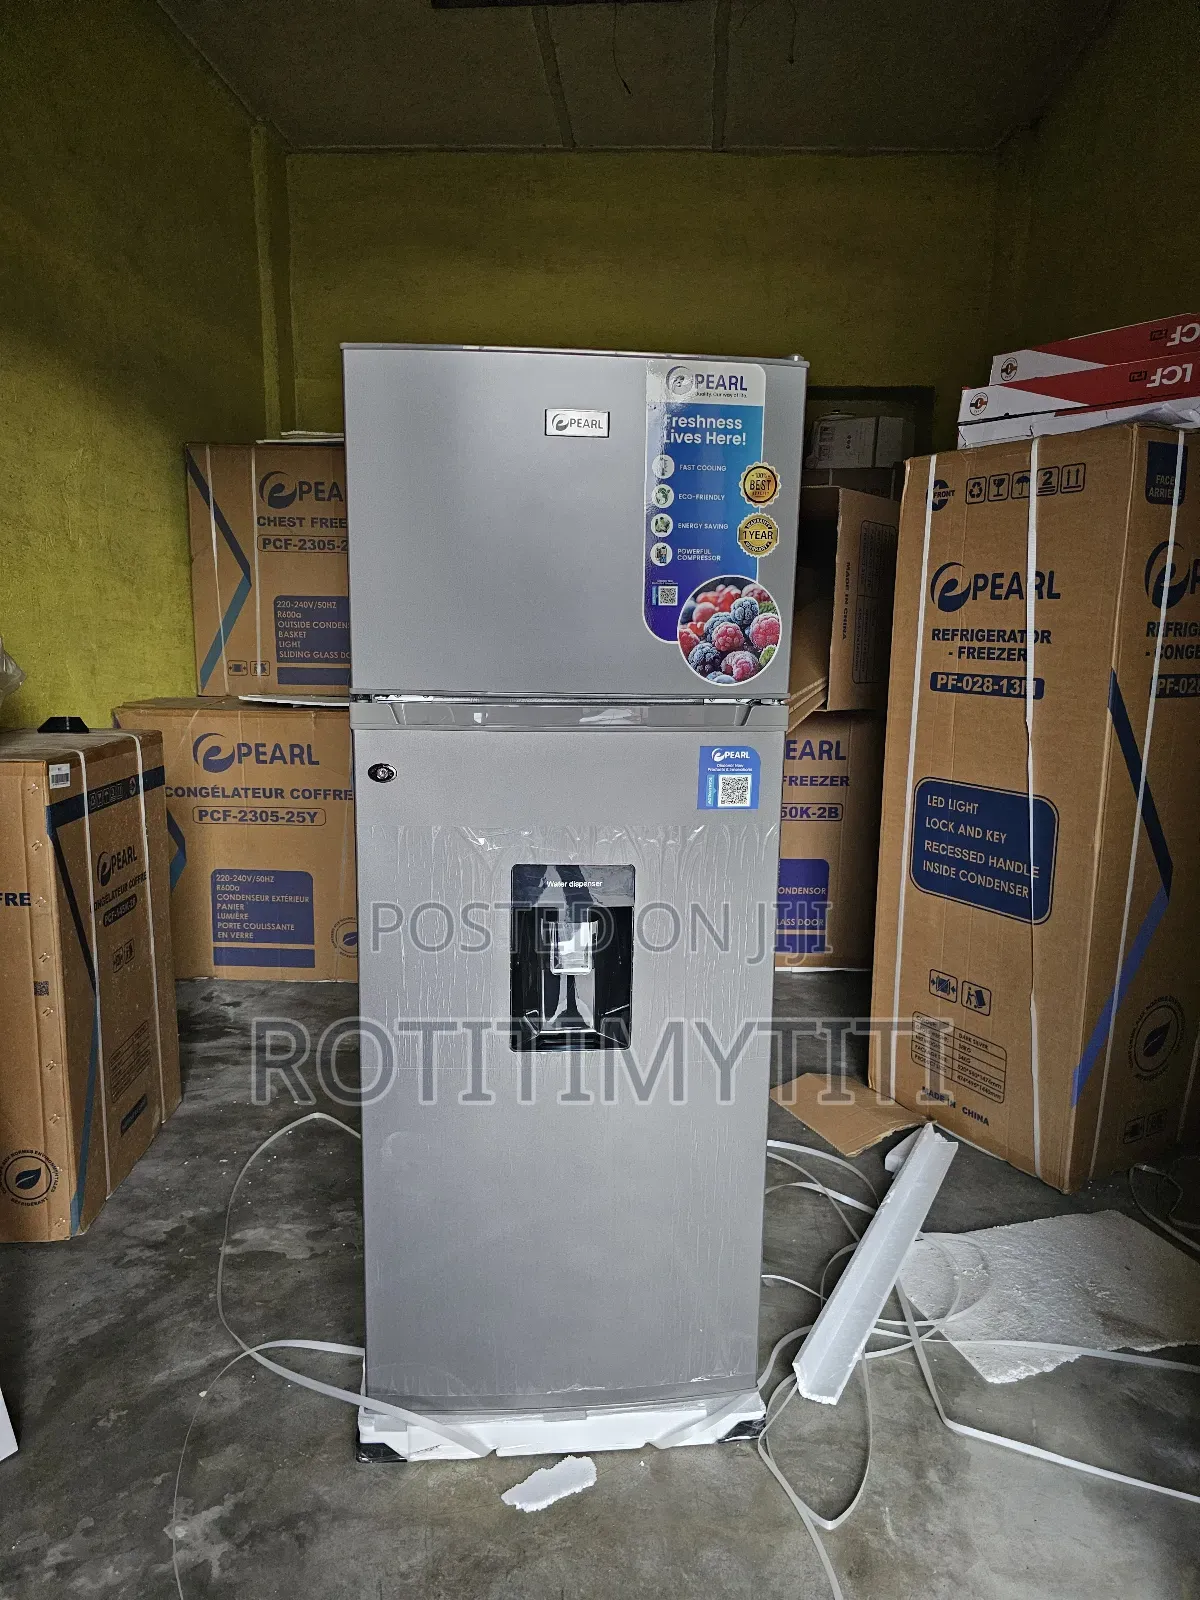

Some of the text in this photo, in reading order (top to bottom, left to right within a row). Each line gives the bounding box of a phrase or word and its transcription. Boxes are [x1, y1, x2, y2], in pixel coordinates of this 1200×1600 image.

[694, 374, 748, 391] PEARL
[1146, 363, 1193, 388] LCF
[569, 418, 604, 430] PEARL
[664, 413, 743, 430] Freshness
[663, 429, 747, 446] Lives Here!
[679, 464, 727, 473] FAST COOLING
[297, 481, 344, 502] PEA
[749, 479, 772, 491] BEST
[678, 493, 726, 501] ECO-FRIENDLY
[933, 489, 955, 499] FRONT
[256, 515, 304, 529] CHEST
[704, 522, 729, 530] SAVING
[748, 530, 774, 540] YEAR
[971, 570, 1062, 601] PEARL
[277, 620, 311, 629] OUTSIDE
[278, 630, 307, 639] BASKET
[931, 628, 1053, 644] REFRIGERATOR
[278, 640, 301, 649] LIGHT
[279, 650, 311, 660] SLIDING
[312, 651, 339, 660] GLASS
[957, 645, 1028, 662] FREEZER
[236, 742, 320, 766] PEARL
[724, 751, 751, 759] PEARL
[785, 739, 847, 761] EARL
[165, 784, 354, 801] CONGÉLATEUR COFFRE
[927, 794, 979, 815] LED LIGHT
[197, 809, 318, 824] PCF-2305-25Y
[926, 816, 1007, 845] LOCK AND KEY
[110, 843, 138, 873] PEARL
[924, 840, 1040, 878] RECESSED HANDLE
[546, 880, 568, 888] Water
[923, 860, 1029, 899] INSIDE CONDENSER
[216, 892, 310, 904] CONDENSEUR EXTÉRIEUR
[216, 902, 245, 911] PANIER
[216, 911, 249, 920] LUMIÈRE
[797, 917, 824, 927] DOOR
[217, 921, 295, 931] PORTE COULISSANTE
[217, 930, 254, 940] EN VERRE
[958, 1032, 989, 1050] DARK SILVER
[961, 1106, 990, 1126] CHINA
